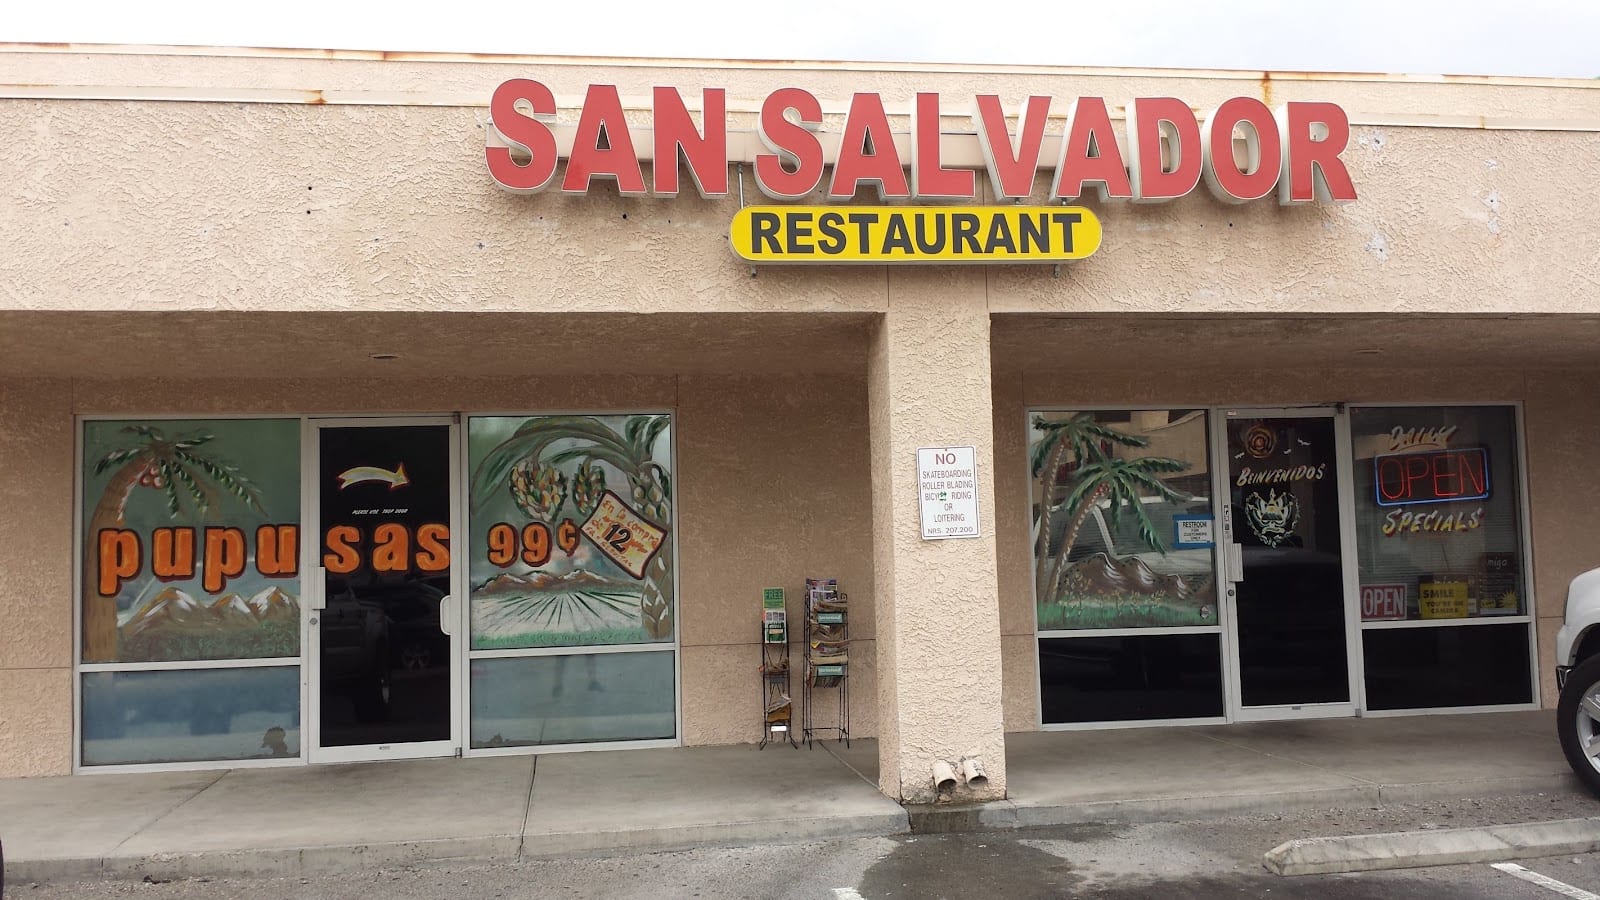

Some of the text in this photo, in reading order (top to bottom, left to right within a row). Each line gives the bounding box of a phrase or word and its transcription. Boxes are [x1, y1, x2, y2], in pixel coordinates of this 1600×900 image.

[485, 79, 1358, 205] SAN SALVADOR
[751, 211, 1082, 255] RESTAURANT
[935, 453, 956, 465] NO
[922, 469, 972, 480] SKATEBOARDING
[1379, 454, 1485, 499] OPEN
[922, 479, 974, 491] ROLLER BLADING
[951, 491, 972, 500] RIDING
[944, 503, 953, 512] OR
[934, 513, 965, 523] LOITERING
[1382, 507, 1484, 537] SPECIALS
[945, 525, 974, 534] 207.200
[764, 590, 783, 599] FREE
[1423, 590, 1455, 599] SMILE
[1362, 588, 1404, 616] OPEN
